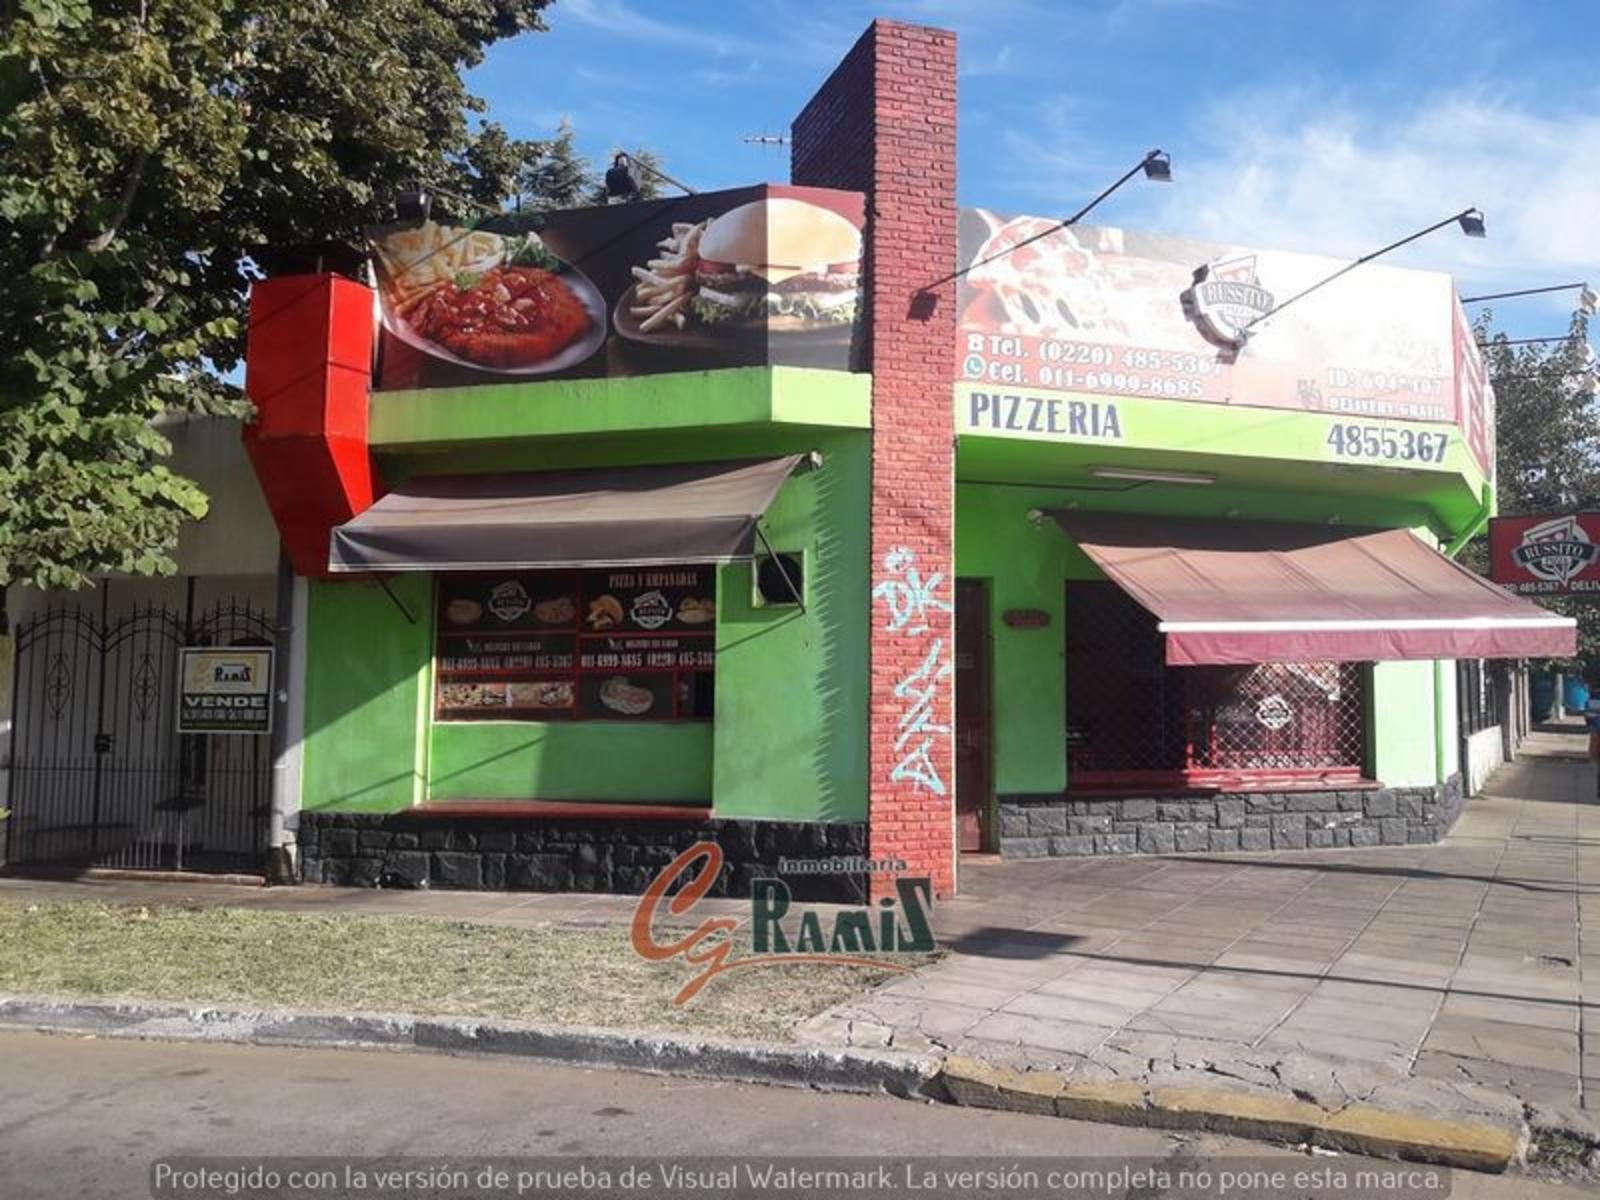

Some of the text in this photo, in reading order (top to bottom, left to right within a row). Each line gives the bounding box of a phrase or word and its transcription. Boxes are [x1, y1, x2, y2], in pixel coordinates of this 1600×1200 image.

[1207, 282, 1267, 307] RUSSITO
[988, 336, 1029, 358] Tel.
[1040, 366, 1202, 396] 011-6999-8685
[970, 392, 1122, 438] PIZZERIA
[1326, 423, 1449, 463] 4855367
[184, 696, 265, 707] VENDE
